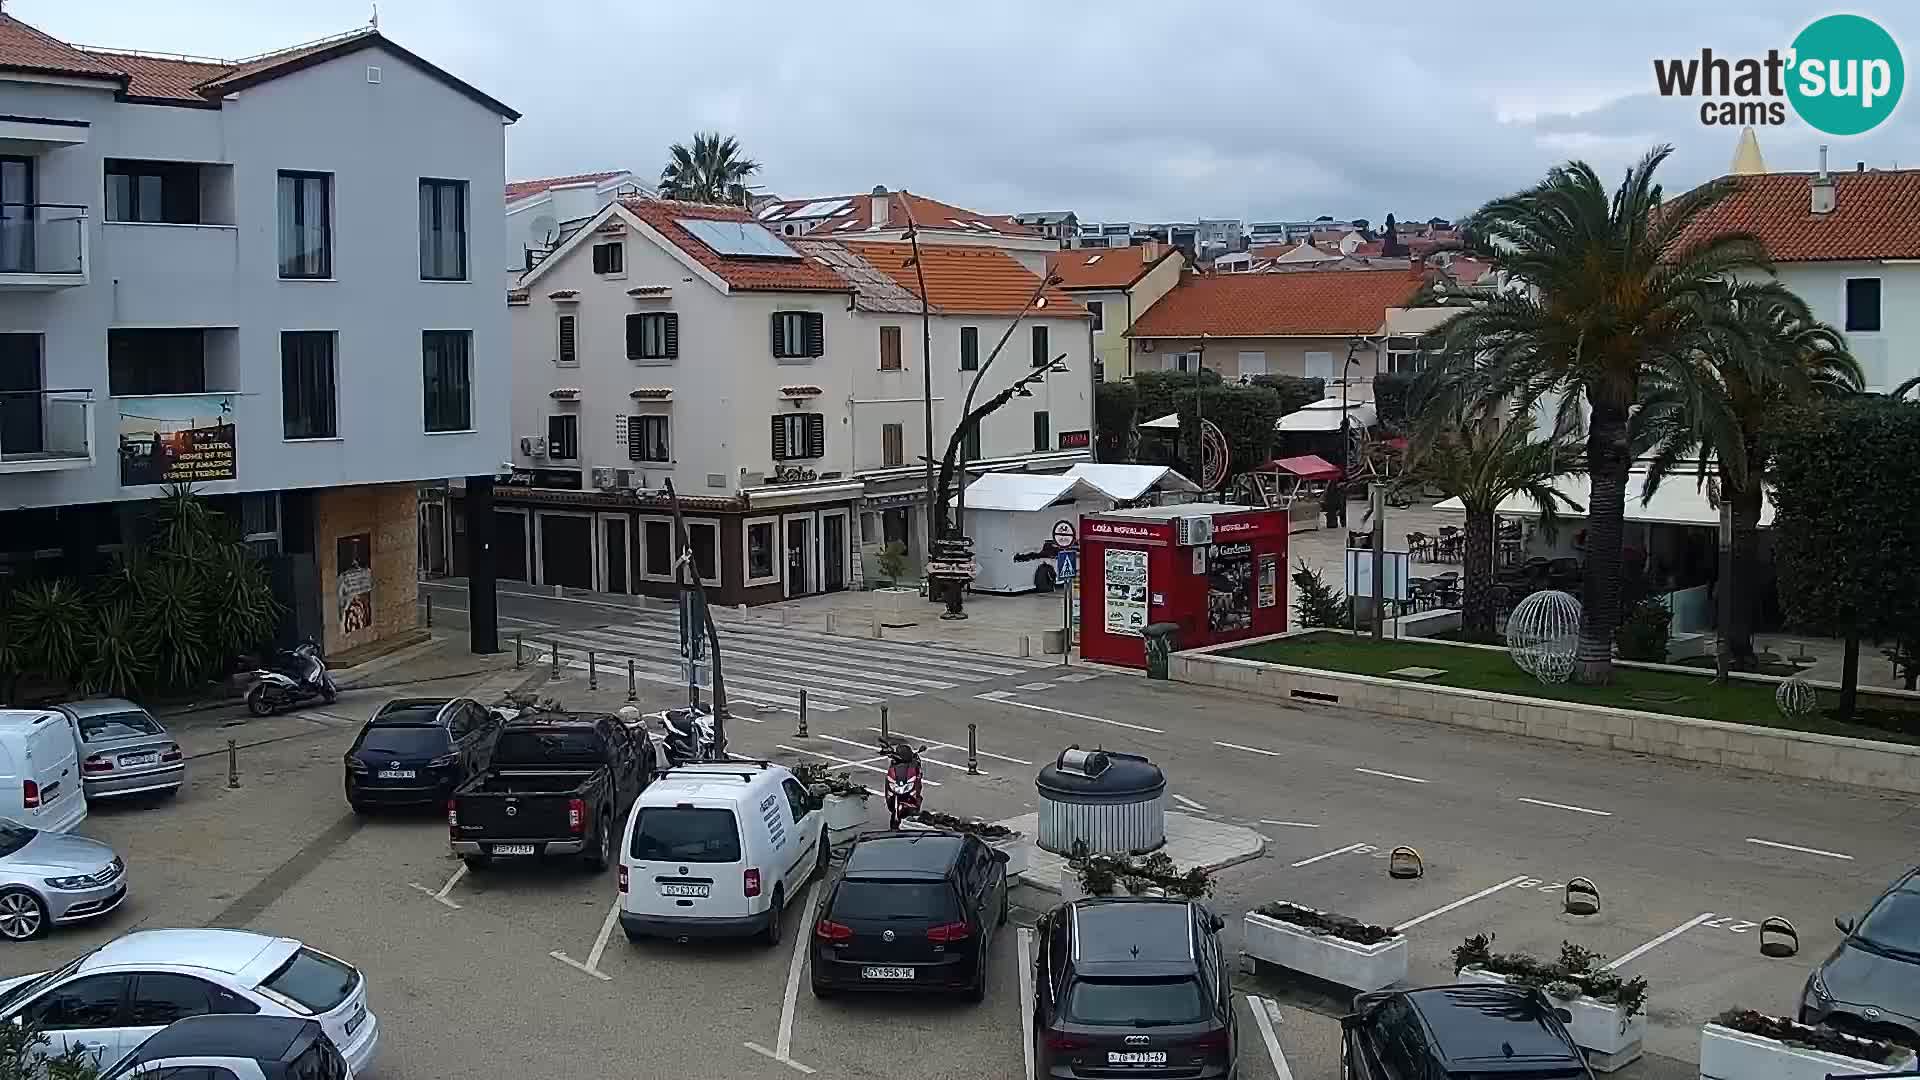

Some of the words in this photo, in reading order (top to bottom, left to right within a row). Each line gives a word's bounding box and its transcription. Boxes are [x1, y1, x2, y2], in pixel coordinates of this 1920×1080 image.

[171, 462, 194, 470] MOST
[195, 460, 232, 469] AMAZING
[162, 471, 193, 480] SUNSET
